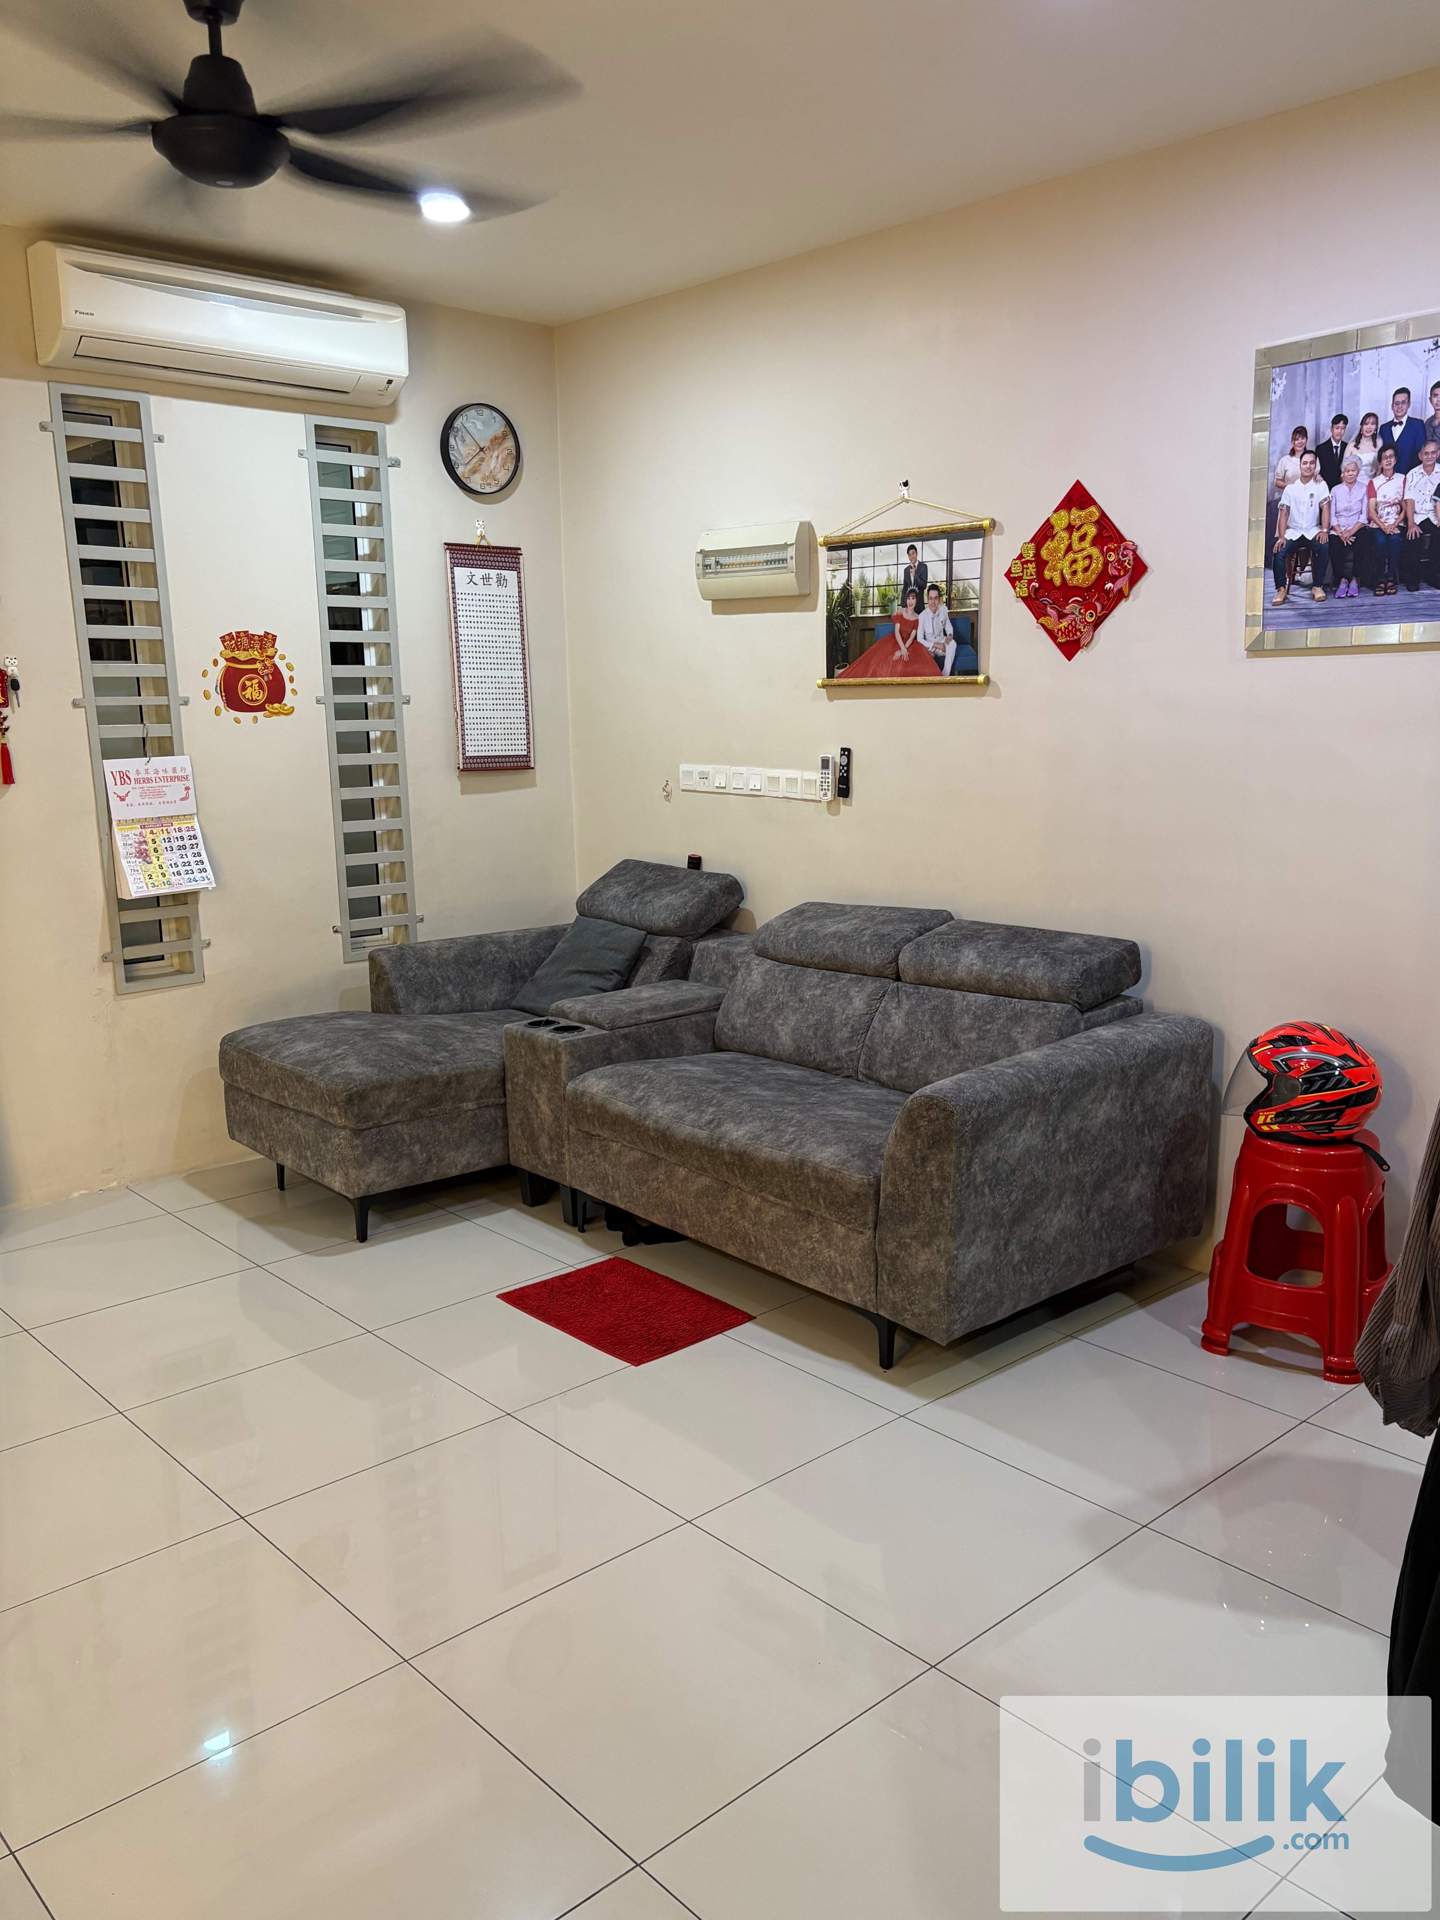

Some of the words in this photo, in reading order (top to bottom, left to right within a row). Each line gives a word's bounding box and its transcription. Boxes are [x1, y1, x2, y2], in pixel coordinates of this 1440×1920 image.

[1040, 504, 1104, 587] 福
[242, 679, 263, 701] 福
[111, 770, 132, 786] YBS
[133, 776, 154, 785] HERBS
[154, 774, 190, 784] ENTERPRISE
